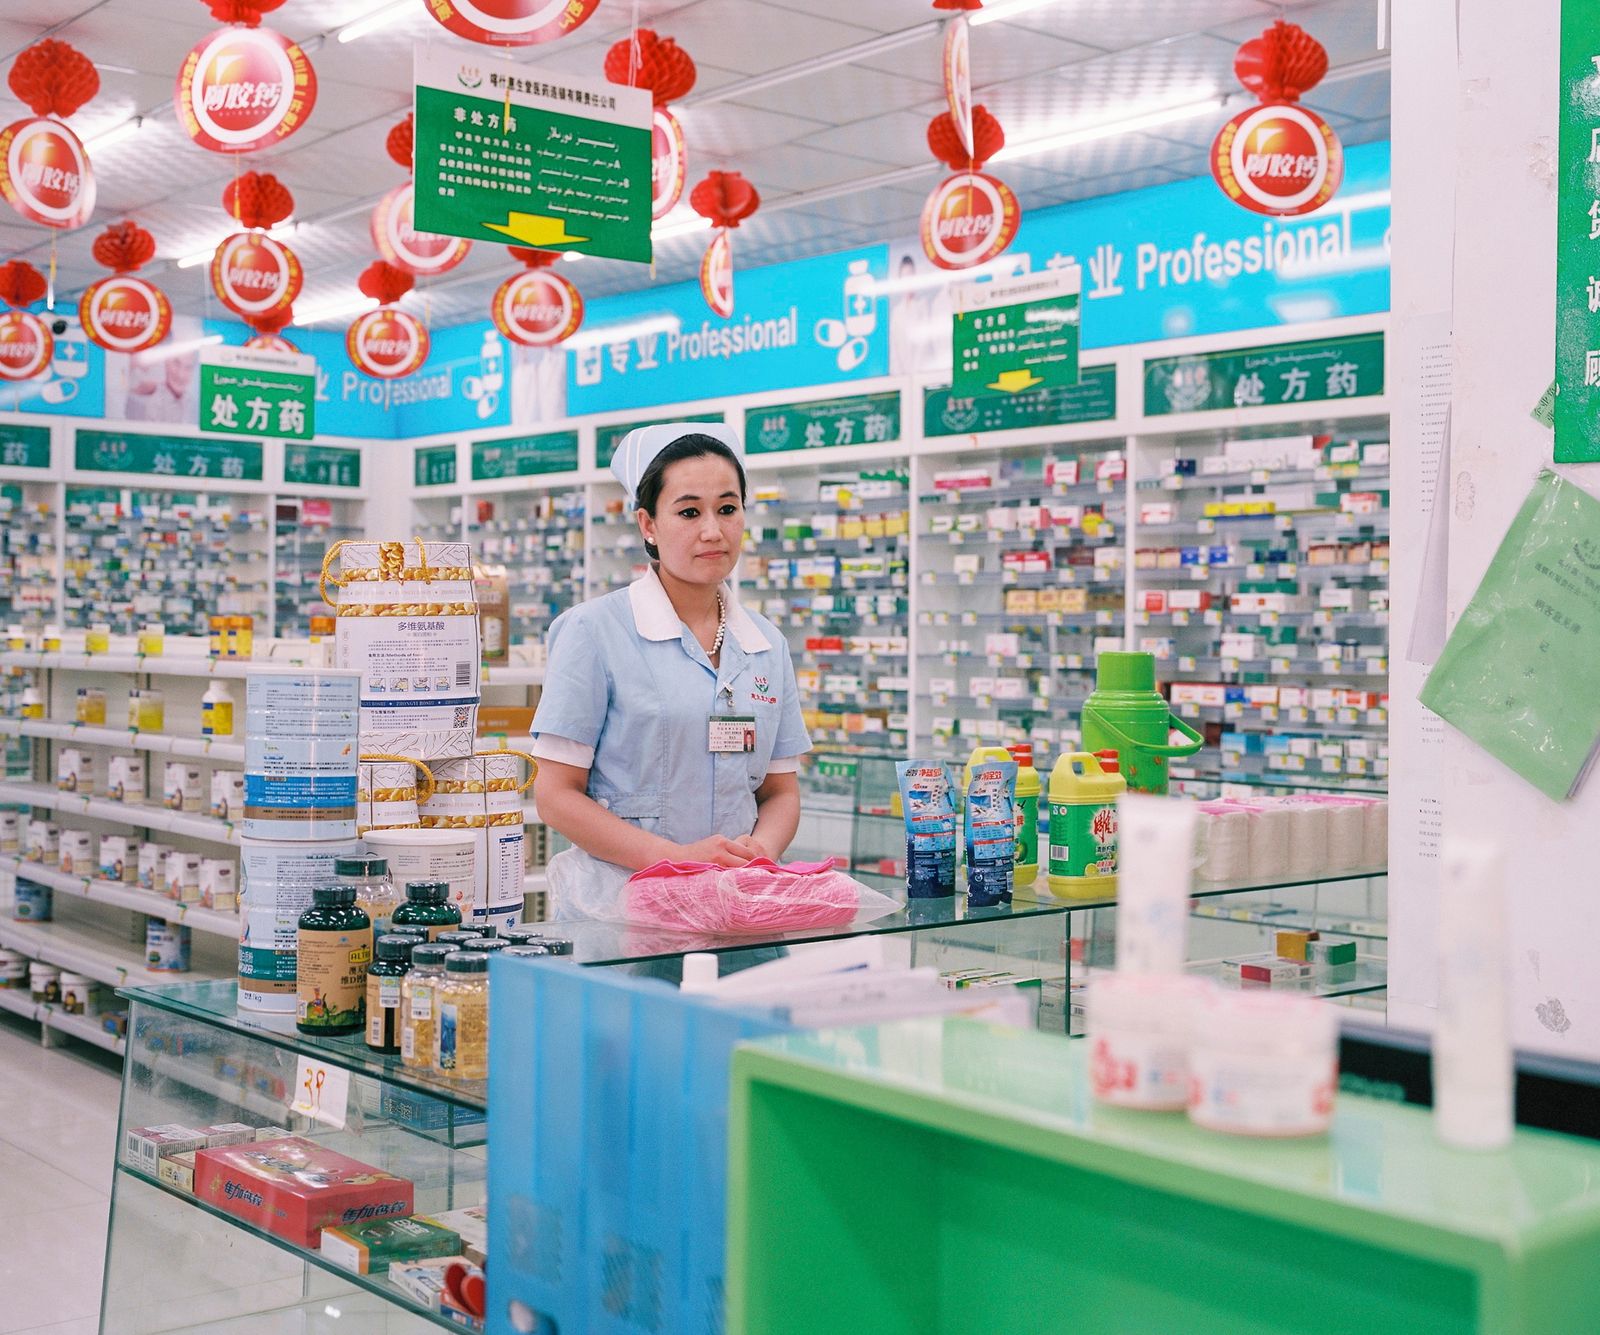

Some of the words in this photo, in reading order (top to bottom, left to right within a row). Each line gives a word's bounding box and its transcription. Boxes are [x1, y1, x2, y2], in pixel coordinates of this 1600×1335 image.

[203, 81, 283, 111] 阿胶钙
[1245, 153, 1319, 179] 阿胶钙
[1136, 210, 1352, 290] Professional
[667, 305, 799, 362] Professional
[1234, 360, 1360, 408] 处方药
[211, 392, 306, 435] 处方药
[804, 412, 888, 448] 处方药
[152, 451, 246, 479] 处方药
[397, 621, 446, 632] 多维氨基酸
